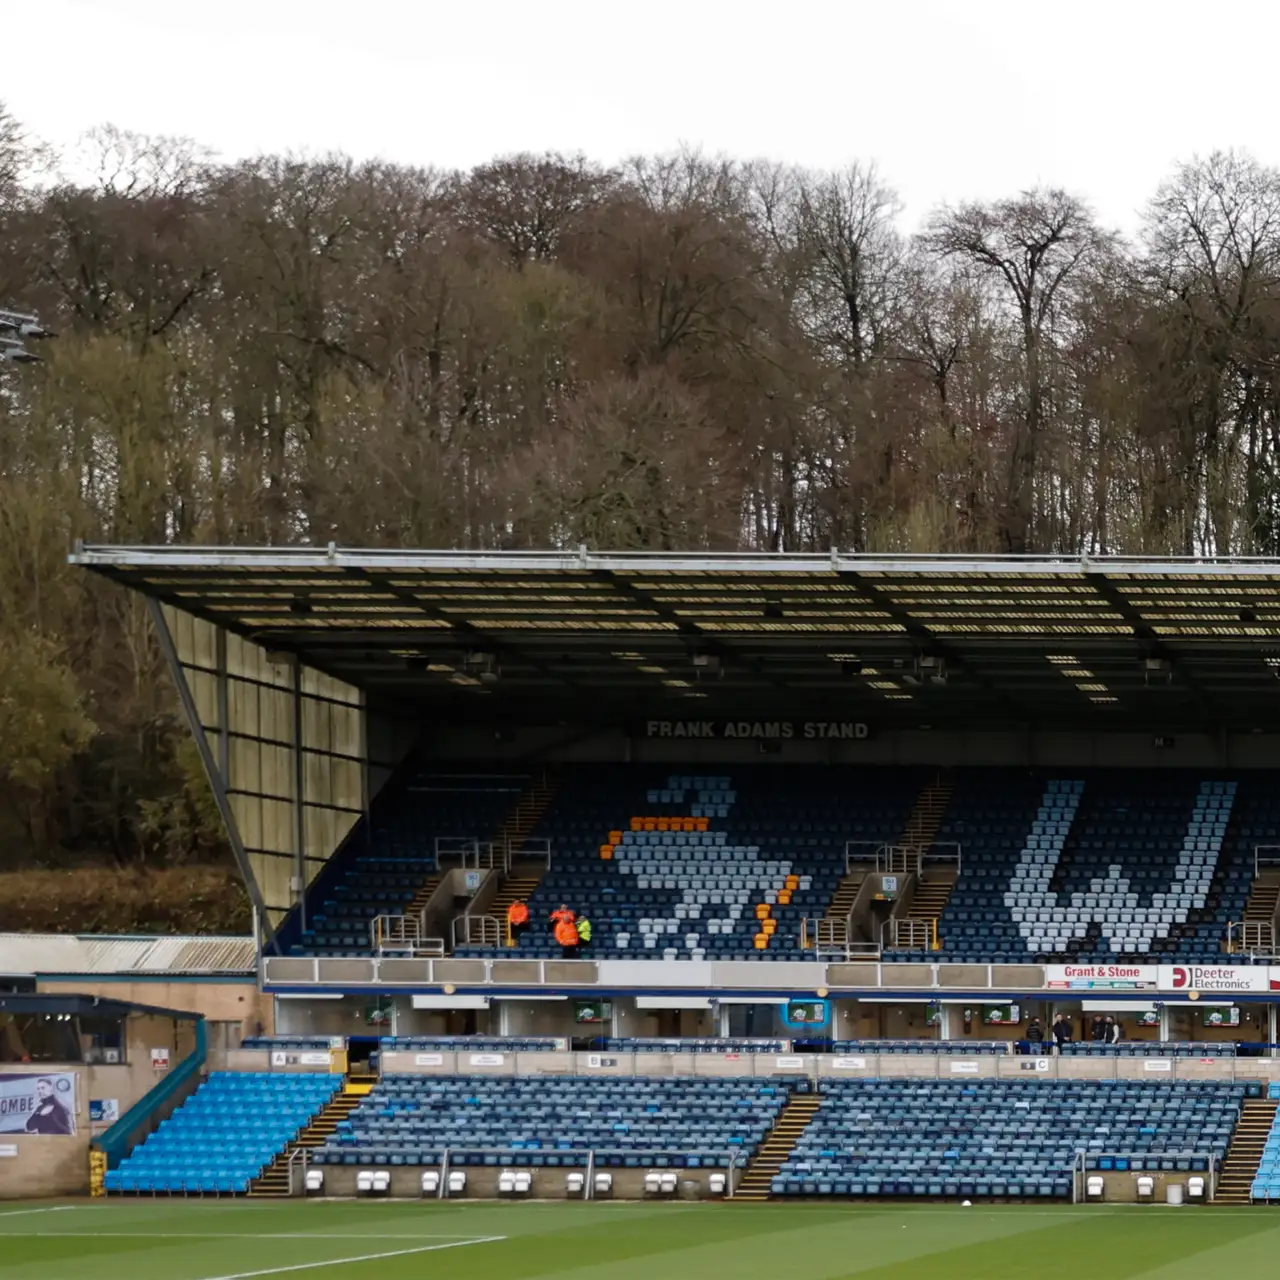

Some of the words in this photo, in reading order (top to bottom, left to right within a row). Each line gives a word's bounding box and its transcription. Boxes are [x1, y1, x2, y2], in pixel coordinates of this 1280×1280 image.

[647, 721, 715, 737] FRANK
[724, 722, 794, 738] ADAMS
[803, 722, 868, 738] STAND
[1064, 966, 1095, 977] Grant
[1097, 966, 1106, 977] &
[1108, 966, 1140, 977] Stone
[1195, 968, 1235, 979] Deeter
[1195, 978, 1250, 989] Electronics
[1038, 1060, 1045, 1069] C
